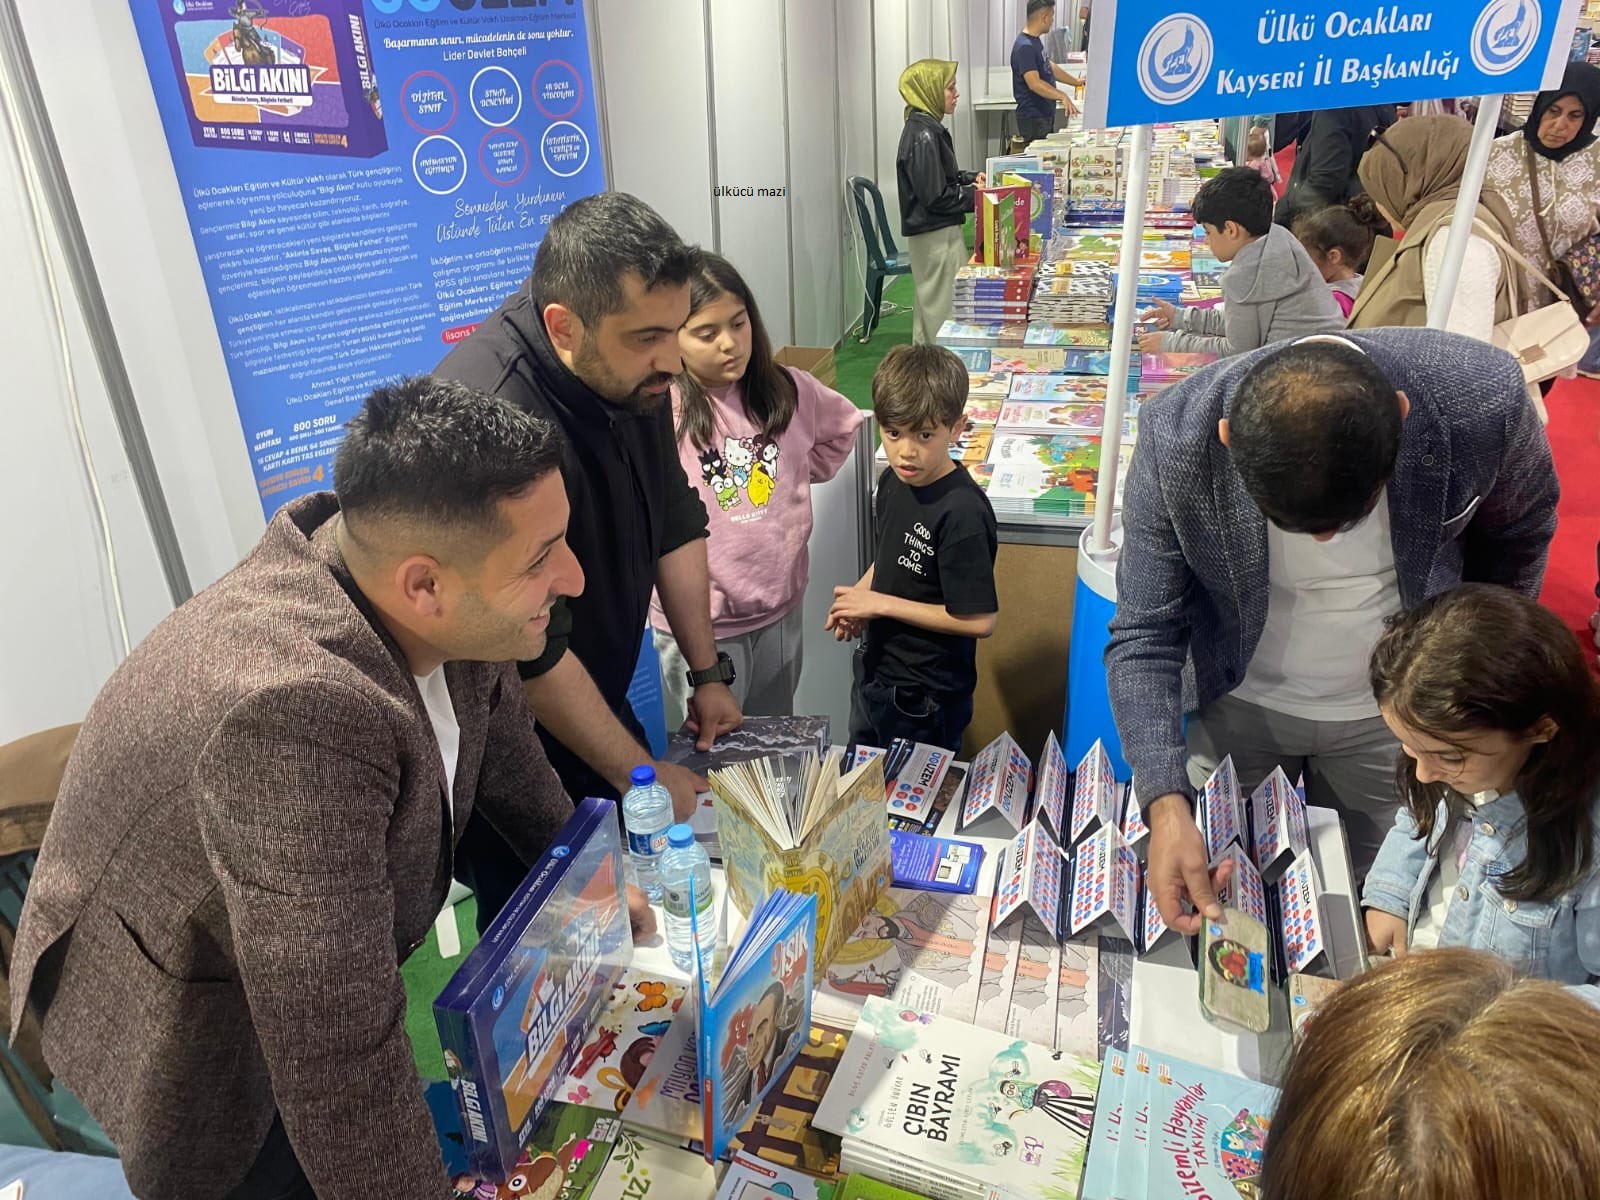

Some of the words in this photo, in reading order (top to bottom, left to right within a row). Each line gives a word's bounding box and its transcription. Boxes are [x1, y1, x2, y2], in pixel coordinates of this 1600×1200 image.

[349, 14, 366, 52] AKINI
[384, 36, 438, 50] Başarmanın
[466, 32, 516, 44] mücadelenin
[517, 31, 526, 41] de
[528, 31, 545, 40] sonu
[443, 50, 466, 62] Lider
[467, 48, 495, 60] Devlet
[496, 46, 527, 59] Bahçeli
[260, 68, 308, 94] AKINI
[193, 186, 210, 198] Ülkü
[211, 184, 244, 195] Ocakları
[244, 180, 270, 192] Eğitim
[348, 169, 364, 178] Türk
[464, 252, 473, 260] ve
[432, 267, 461, 279] çalışma
[434, 280, 456, 289] KPSS
[458, 276, 472, 287] gibi
[474, 271, 504, 282] sınavlara
[436, 289, 454, 300] Ülkü
[456, 286, 488, 296] Ocakları
[490, 280, 512, 292] Eğitim
[514, 278, 522, 286] ve
[438, 301, 463, 312] Eğitim
[445, 329, 470, 341] lisans
[311, 379, 334, 390] Ahmet
[293, 420, 311, 433] 800
[313, 414, 336, 428] SORU
[312, 464, 324, 482] 4
[730, 513, 750, 522] HELLO
[751, 508, 768, 518] KITTY
[913, 522, 931, 540] GOOD
[904, 532, 934, 556] THINGS
[910, 550, 921, 562] TO
[898, 556, 928, 576] COME.
[926, 1054, 961, 1142] BAYRAMI
[902, 1082, 932, 1136] ÇIBIN
[1162, 1081, 1208, 1138] Hayvanlar
[1191, 1110, 1209, 1168] TAKVİMİ
